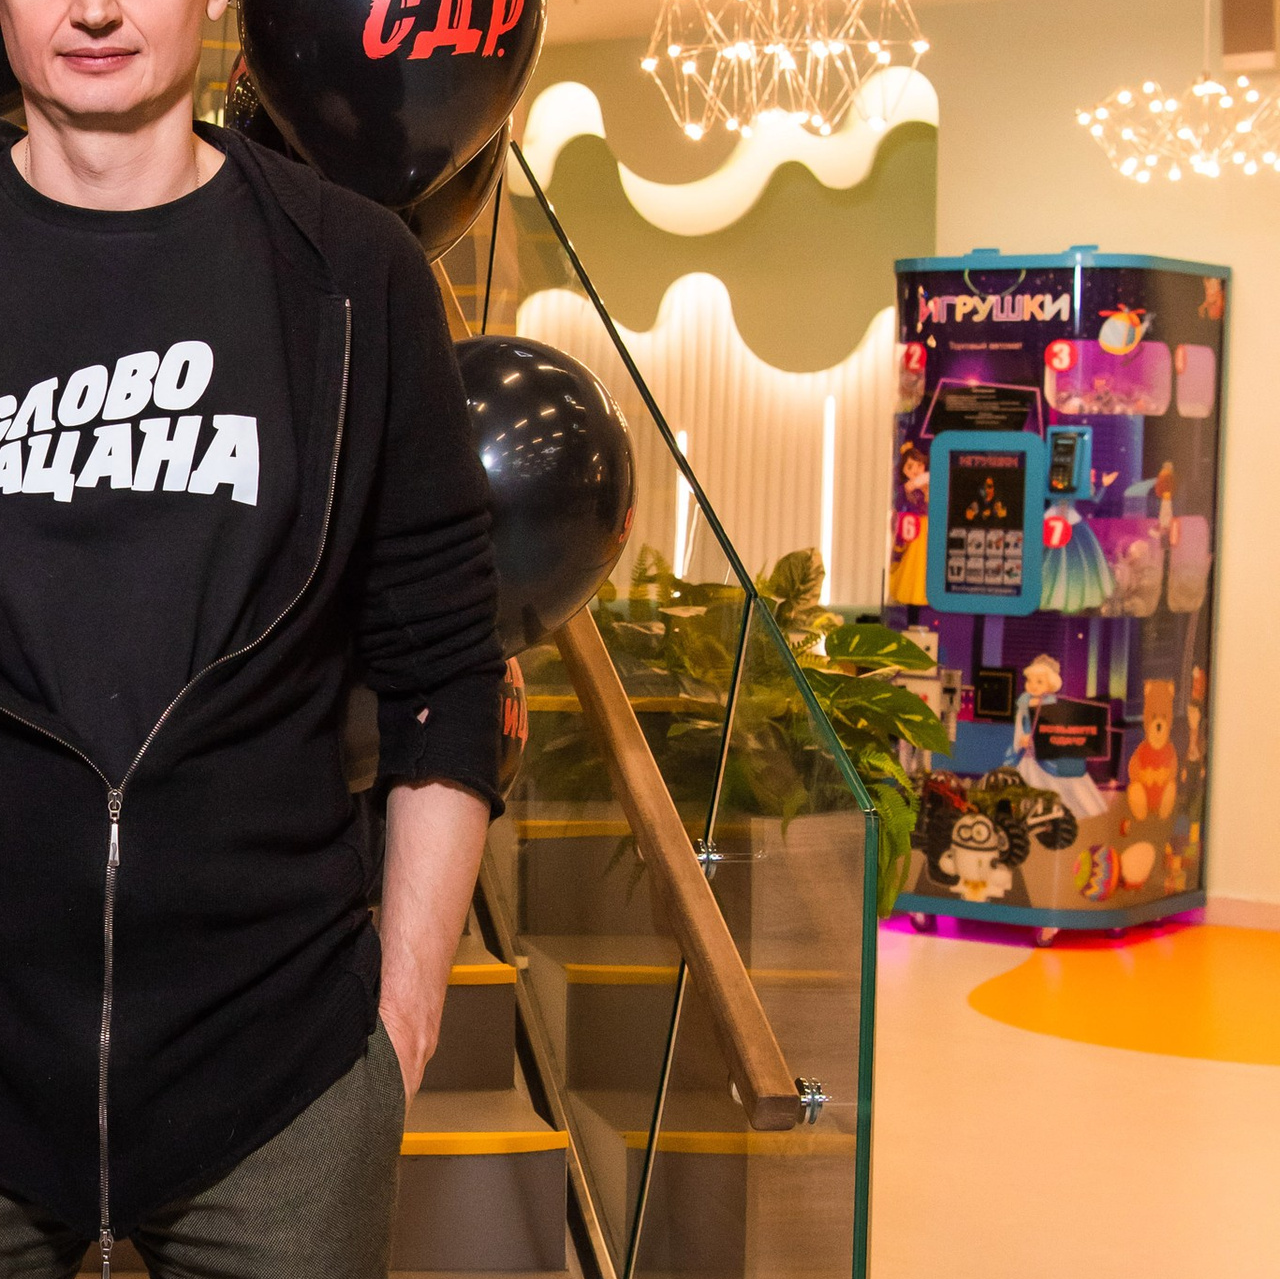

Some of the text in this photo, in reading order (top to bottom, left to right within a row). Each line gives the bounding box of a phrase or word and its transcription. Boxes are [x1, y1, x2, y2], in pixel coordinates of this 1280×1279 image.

[919, 293, 1071, 324] ИГРУШКИ
[907, 344, 922, 371] 2
[1051, 342, 1071, 371] 3
[901, 520, 917, 543] 6
[1047, 522, 1065, 545] 7
